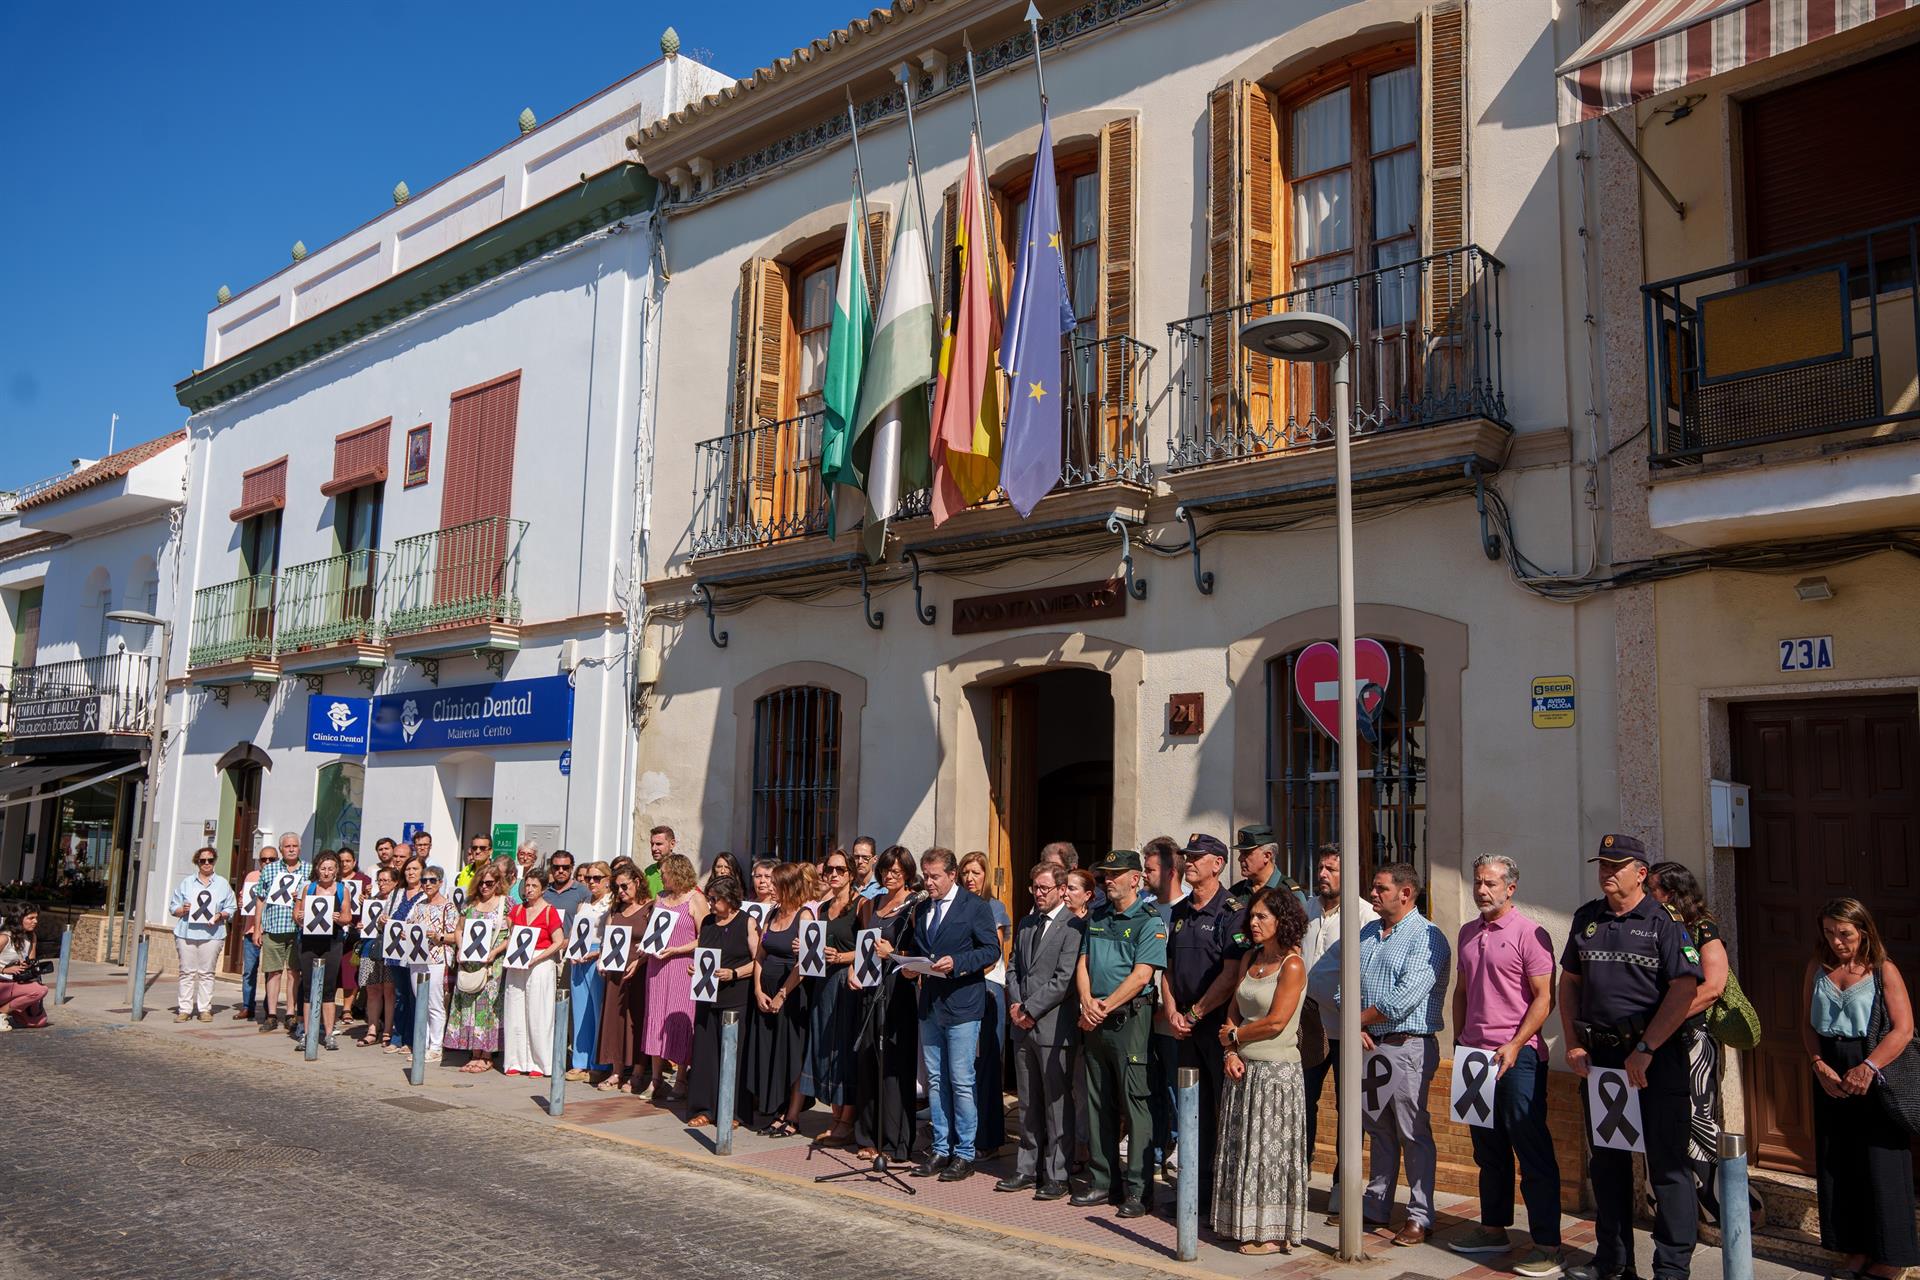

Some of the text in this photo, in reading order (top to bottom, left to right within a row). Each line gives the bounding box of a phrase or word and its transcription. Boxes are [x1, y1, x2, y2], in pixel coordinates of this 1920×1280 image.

[1780, 638, 1832, 670] 23A
[432, 691, 532, 722] Clínica Dental
[1173, 703, 1195, 722] 21
[312, 732, 364, 744] Clínica Dental
[447, 725, 512, 740] Mairena Centro
